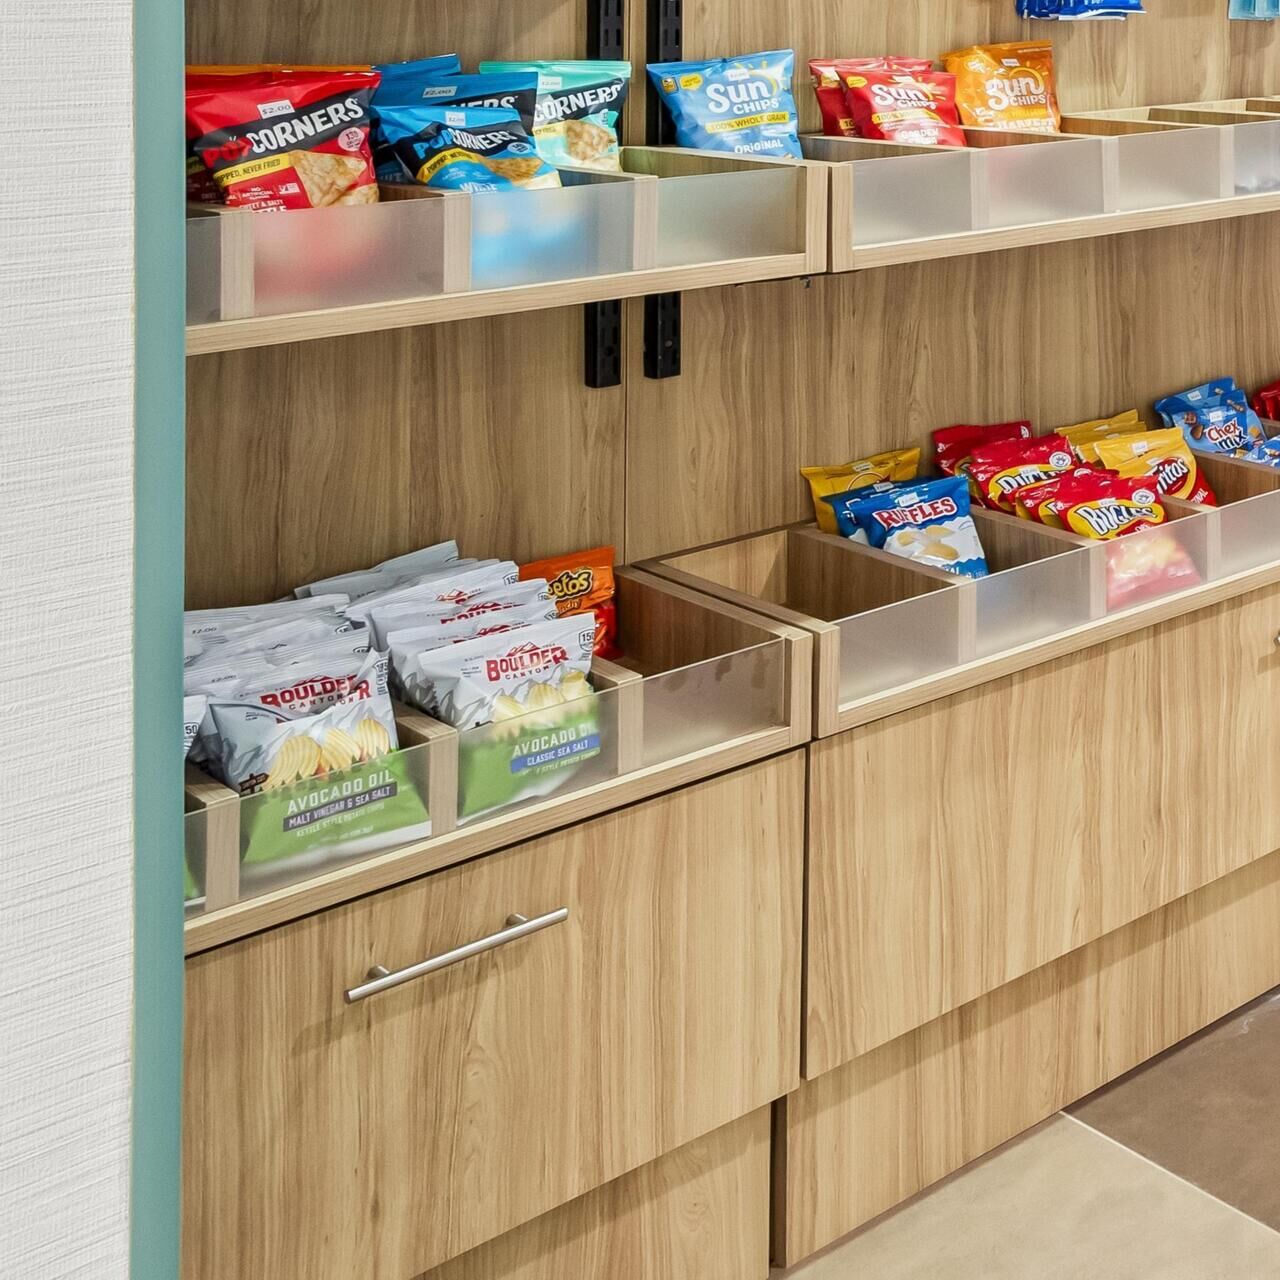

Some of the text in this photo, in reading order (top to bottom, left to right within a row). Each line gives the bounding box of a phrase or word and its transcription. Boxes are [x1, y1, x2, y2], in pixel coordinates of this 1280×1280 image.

[706, 80, 772, 115] Sun
[732, 99, 780, 115] CHIPS
[871, 83, 928, 106] Sun
[897, 101, 937, 110] CHIPS
[986, 77, 1046, 111] Sun
[1009, 95, 1046, 106] CHIPS
[262, 104, 291, 115] $2.00
[735, 112, 787, 128] WHOLE GRAIN
[246, 97, 364, 154] CORNERS
[733, 138, 784, 154] ORIGINAL
[242, 162, 262, 176] NEVER
[1207, 420, 1238, 443] Chex
[1157, 458, 1190, 495] ritos
[873, 496, 957, 530] RUFFLES
[549, 570, 592, 596] etos
[486, 646, 569, 682] BOULDER
[505, 665, 550, 681] CANYON
[512, 729, 576, 758] AVOCADO
[527, 739, 589, 766] CLASSIC SEA SALT
[287, 769, 395, 815] AVOCADO OIL
[288, 786, 391, 828] MALT VINEGAR SEA SALT
